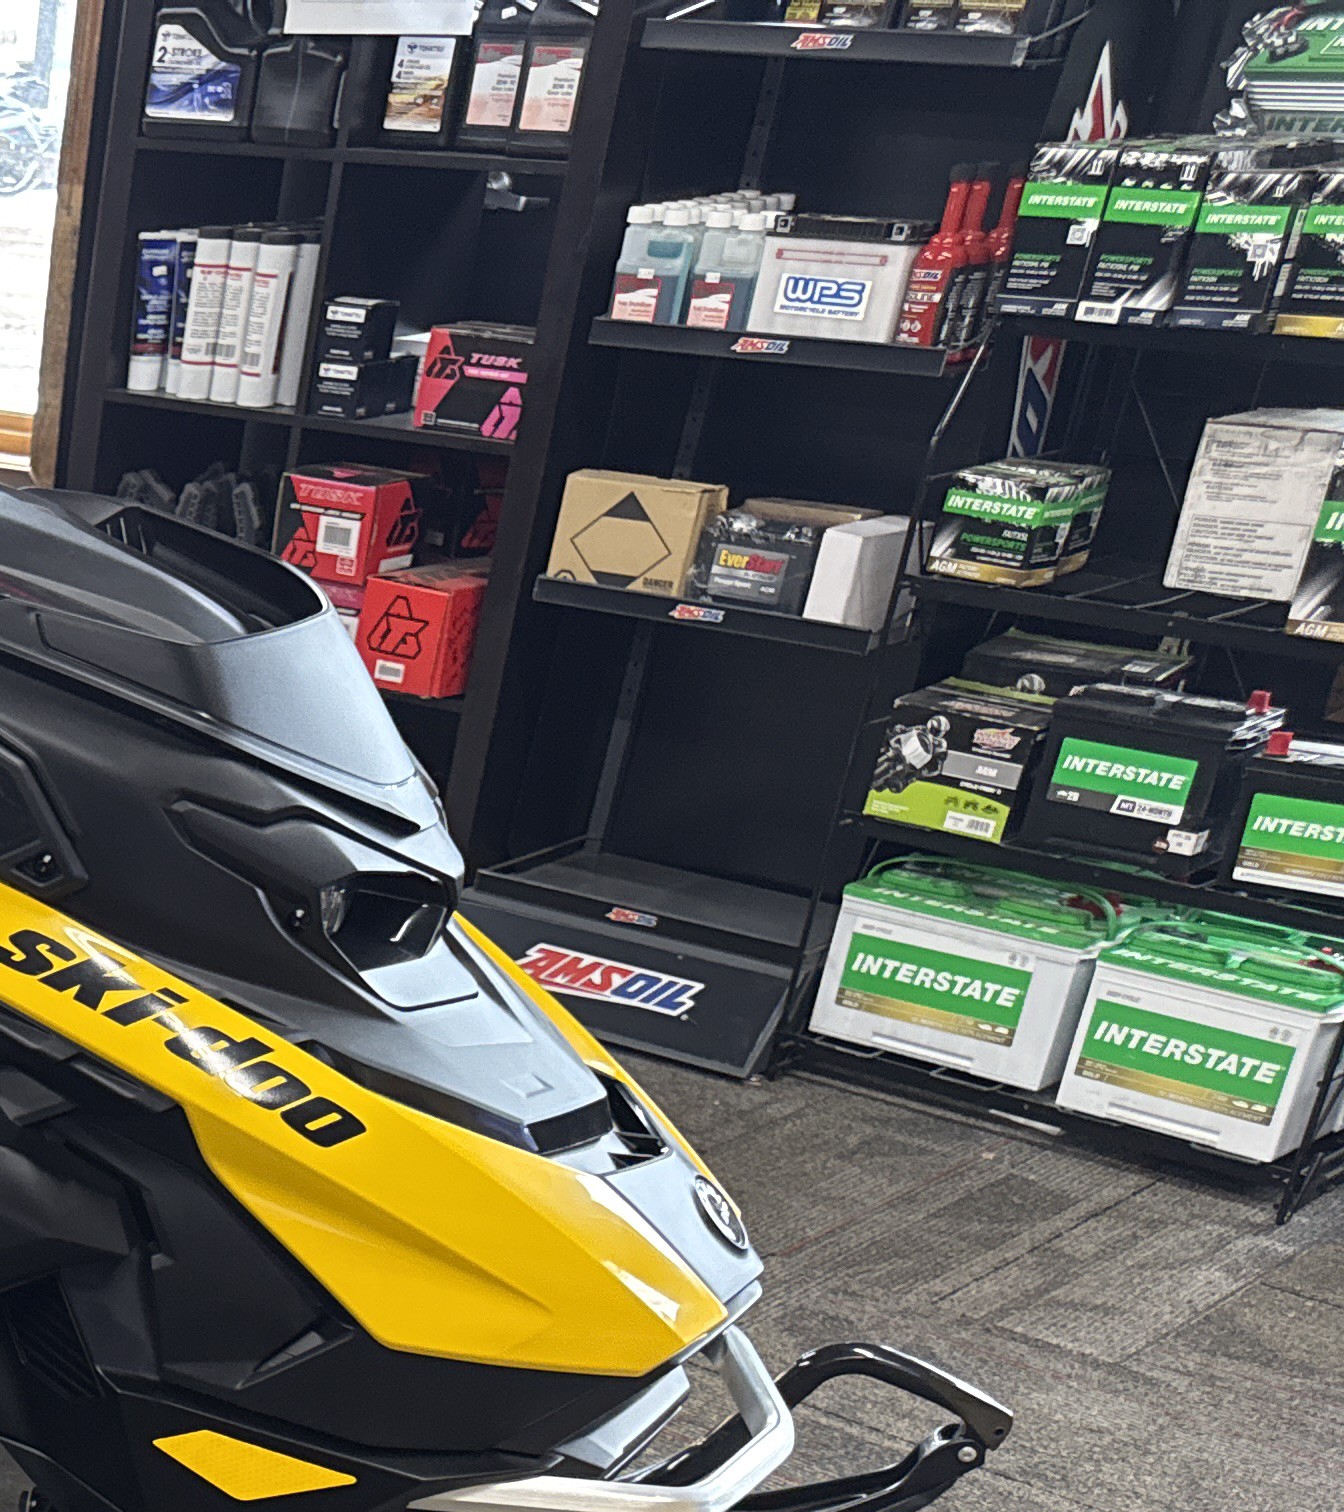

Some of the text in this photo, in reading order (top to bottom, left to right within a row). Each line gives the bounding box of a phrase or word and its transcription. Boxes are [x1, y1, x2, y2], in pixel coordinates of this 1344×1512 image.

[793, 33, 854, 49] AMSOIL
[1027, 194, 1098, 208] INTERSTATE
[1113, 199, 1188, 215] INTERSTATE
[1205, 213, 1279, 226] INTERSTATE
[785, 276, 866, 307] WPS
[469, 352, 523, 369] TUSK
[947, 494, 1038, 520] INTERSTATE
[718, 549, 785, 575] EverStart
[929, 560, 958, 574] AGM
[1294, 622, 1329, 638] AGM
[1062, 754, 1186, 791] INTERSTATE
[1252, 815, 1344, 844] INTERST
[521, 947, 697, 1011] AMSOIL
[850, 951, 1021, 1008] INTERSTATE
[1093, 1020, 1281, 1085] INTERSTATE
